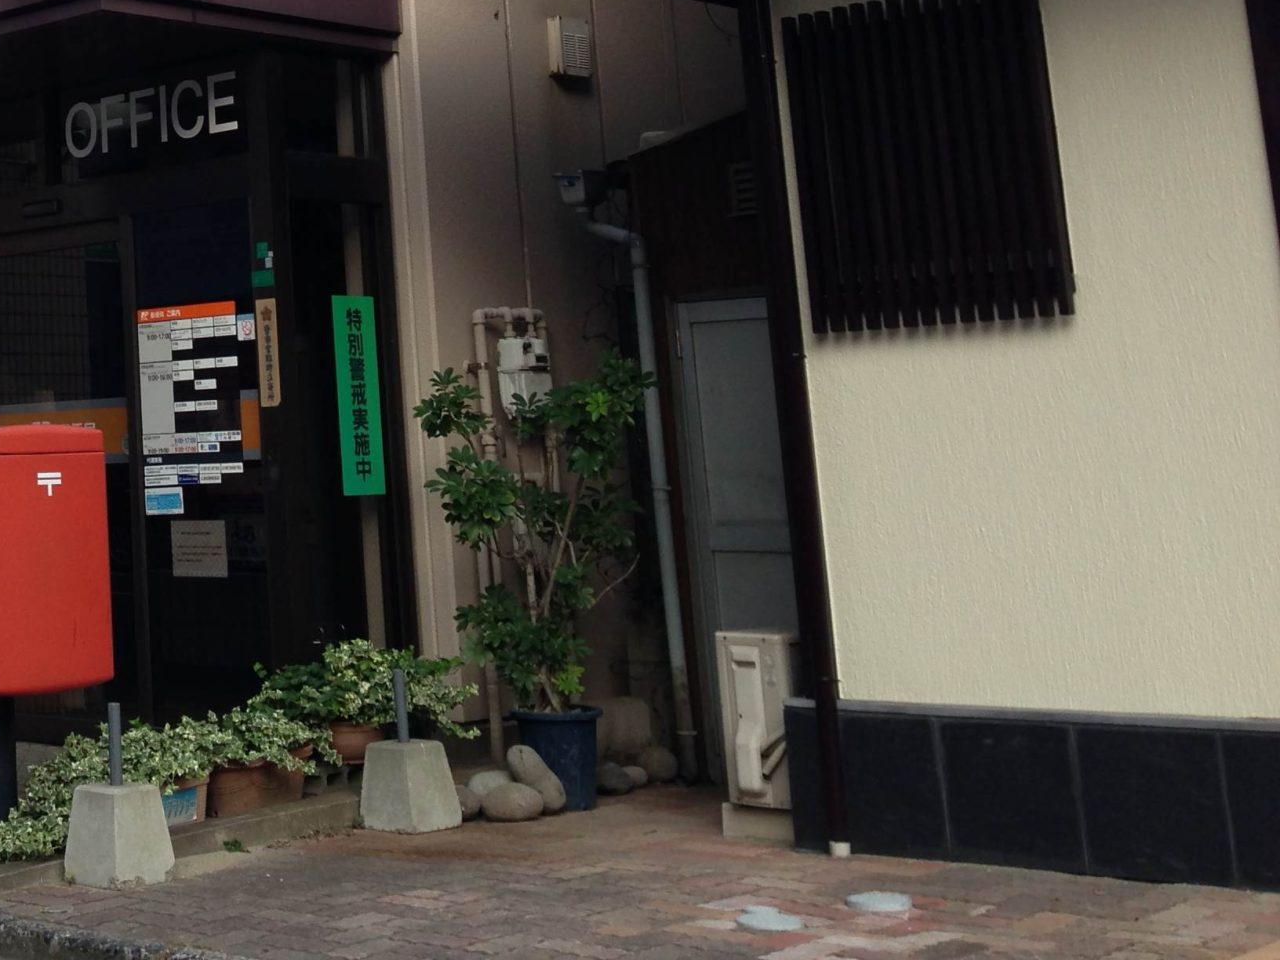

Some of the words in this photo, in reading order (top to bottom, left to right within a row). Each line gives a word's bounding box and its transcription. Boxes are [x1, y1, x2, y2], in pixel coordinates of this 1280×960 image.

[65, 71, 238, 159] OFFICE
[345, 307, 373, 482] 特別警戒実施中
